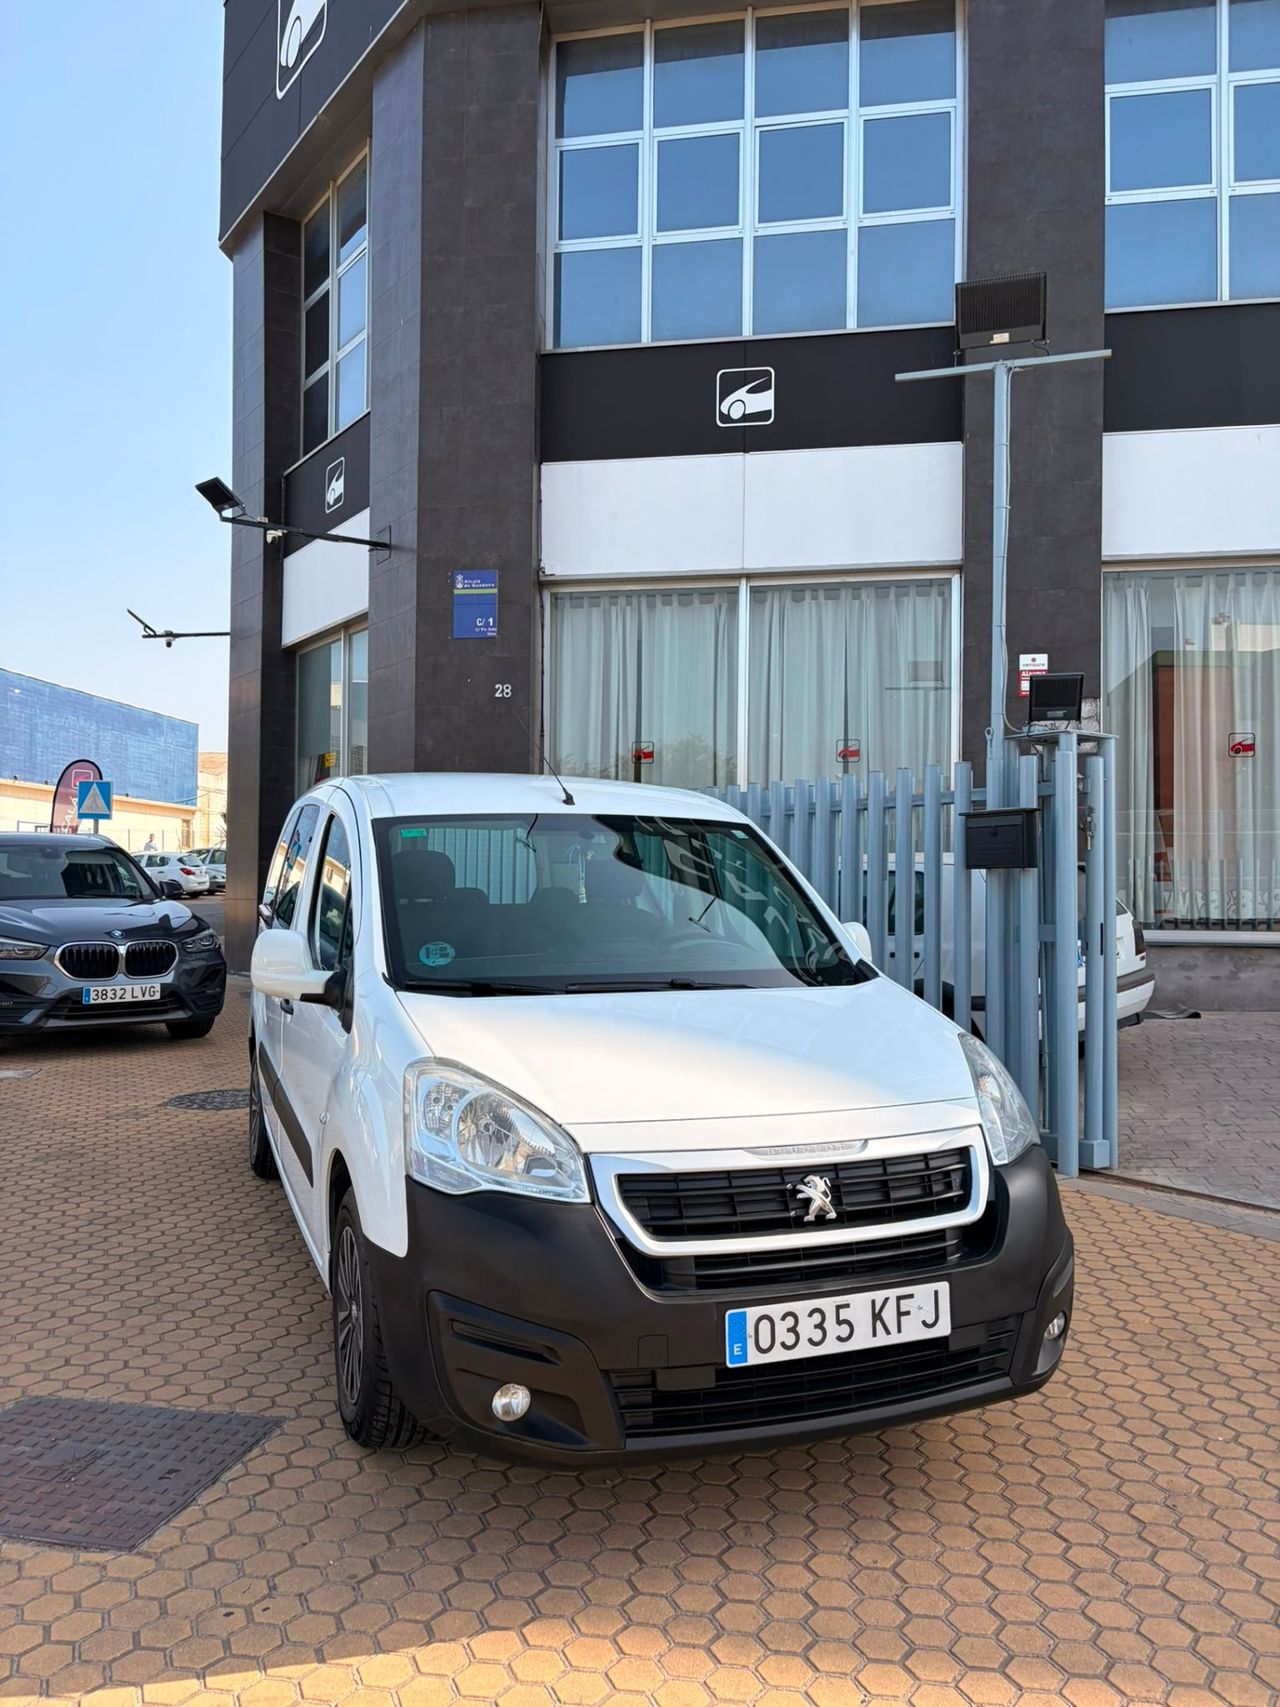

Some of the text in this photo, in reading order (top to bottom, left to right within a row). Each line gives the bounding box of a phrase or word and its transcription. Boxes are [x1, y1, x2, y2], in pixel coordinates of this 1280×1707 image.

[476, 617, 494, 627] C/ 1
[494, 683, 512, 698] 28
[92, 985, 156, 1001] 3832 LVG
[733, 1289, 940, 1356] E 0335 KFJ
